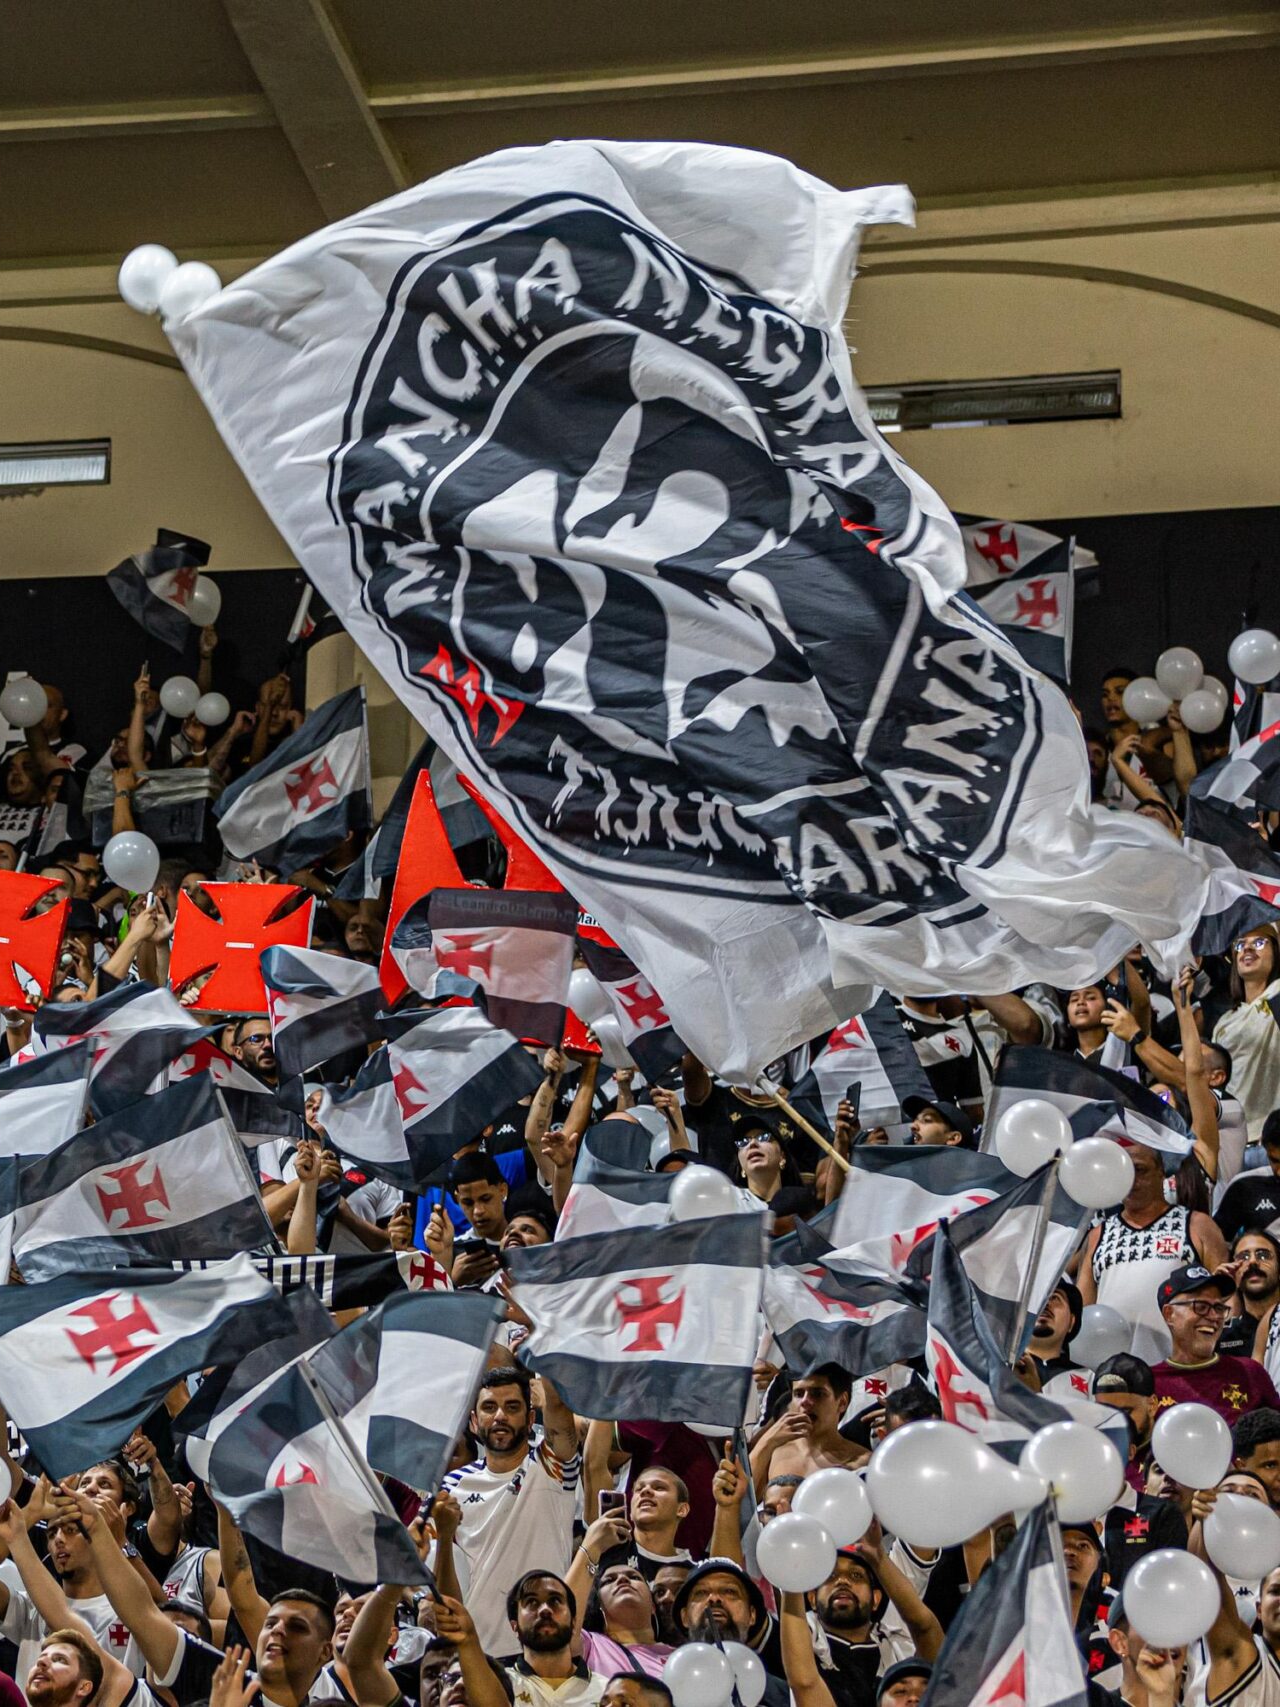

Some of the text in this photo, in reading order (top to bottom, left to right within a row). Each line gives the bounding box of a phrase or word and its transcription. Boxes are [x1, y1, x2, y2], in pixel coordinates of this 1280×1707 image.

[354, 231, 881, 618] MANCHA NEGRA
[548, 734, 766, 862] TIJUC
